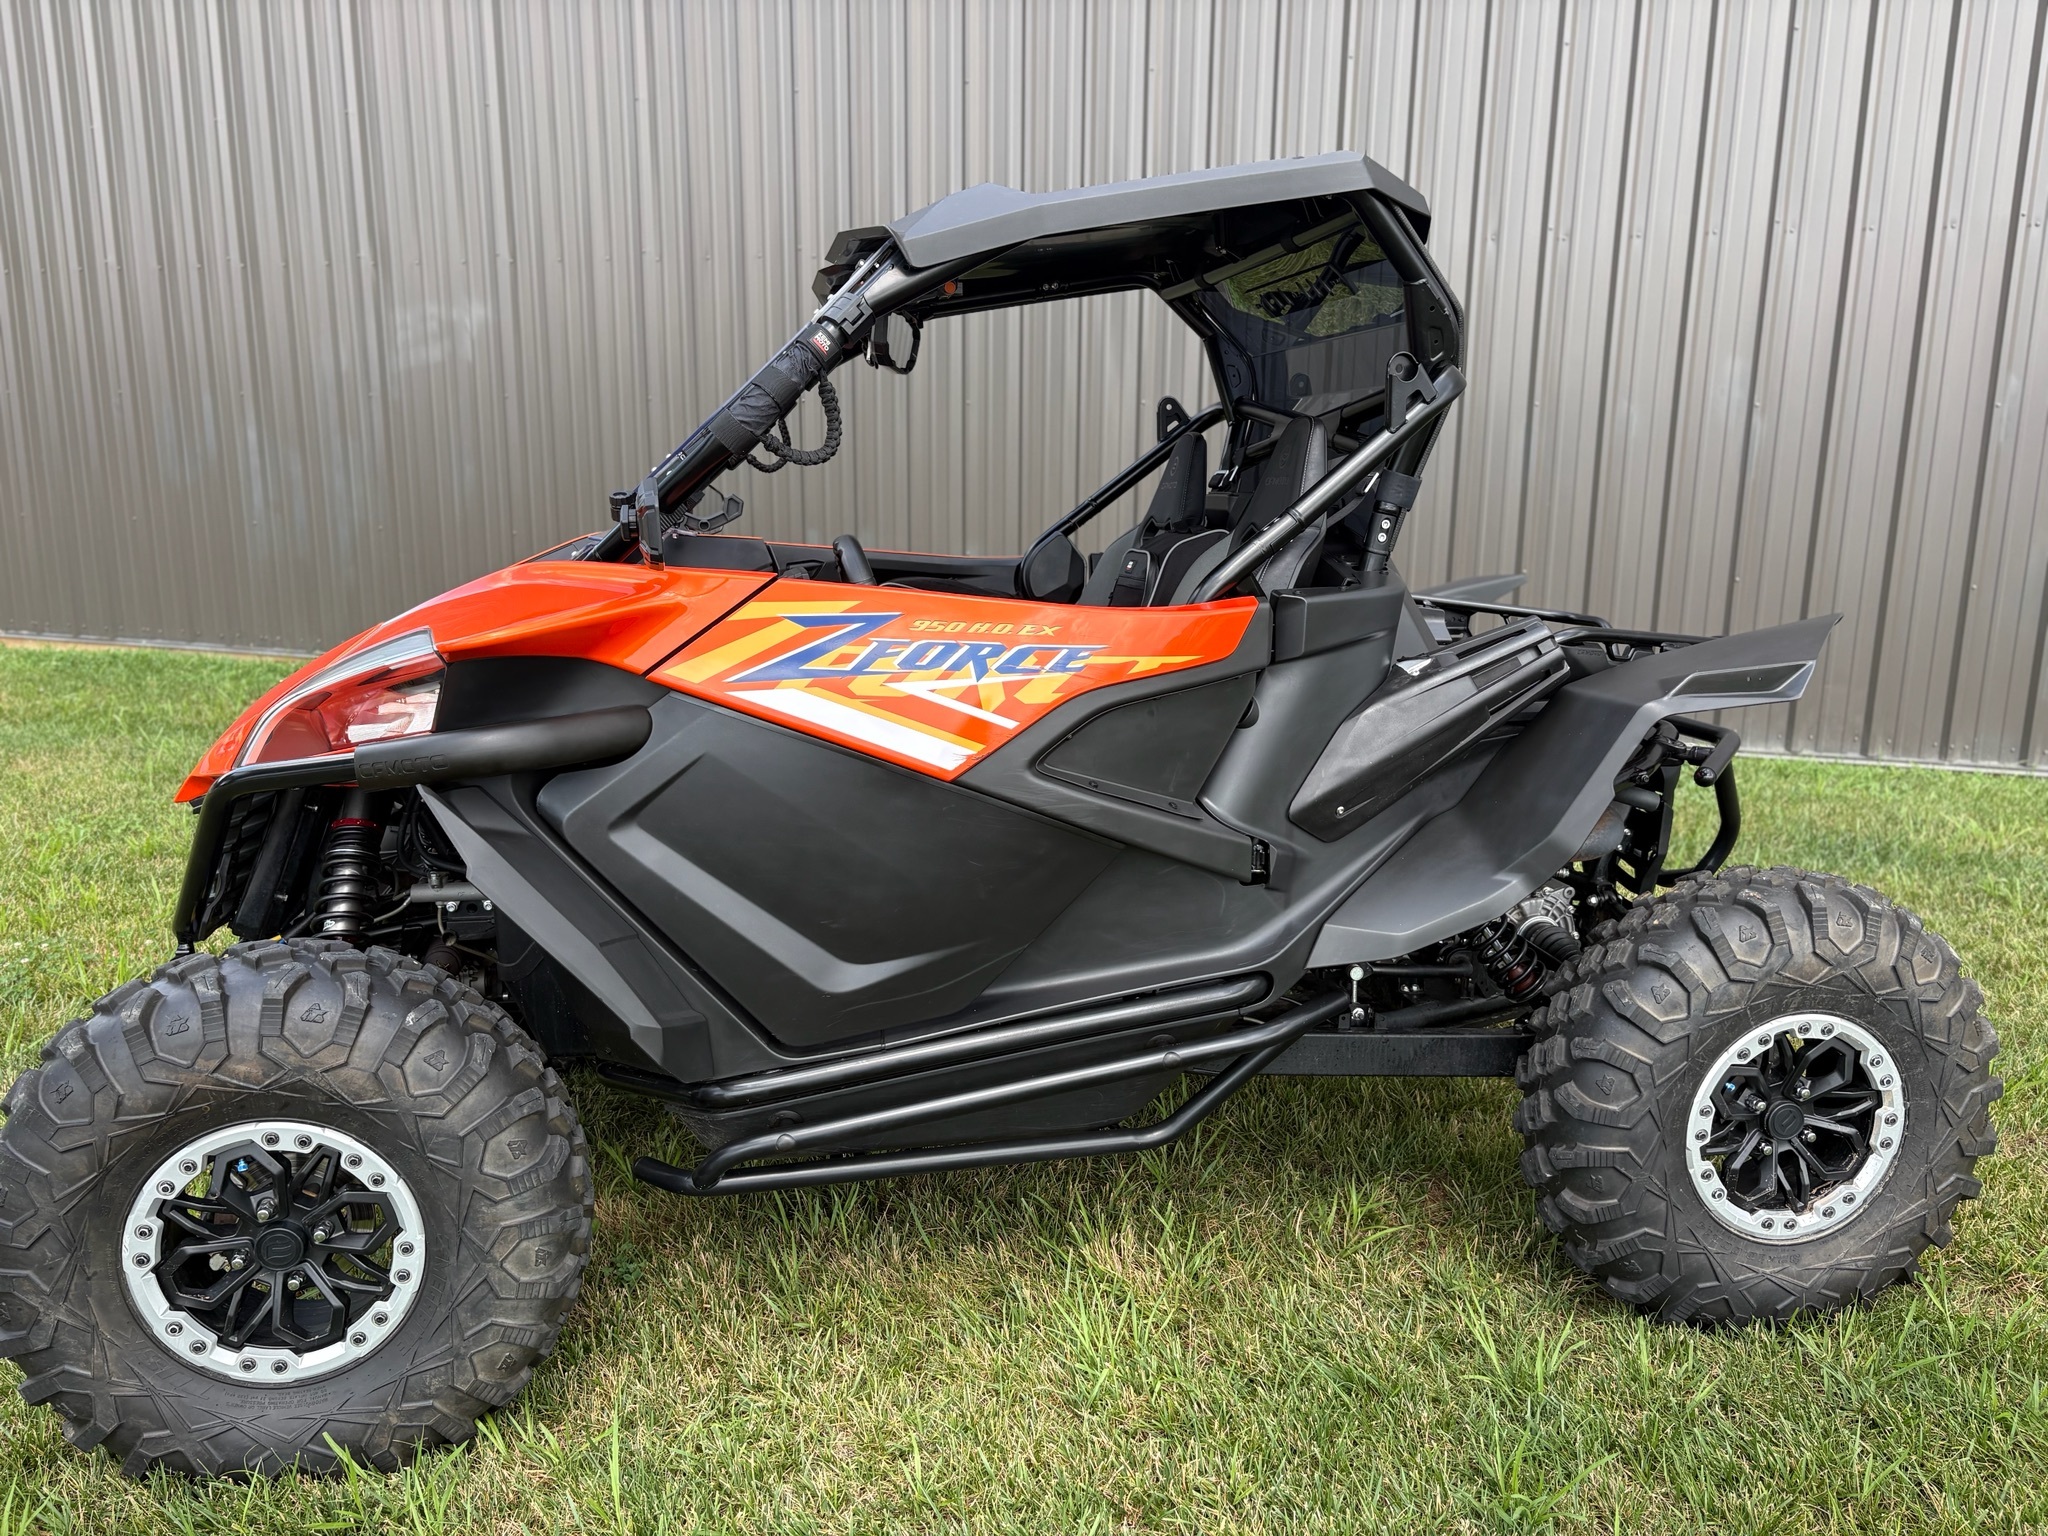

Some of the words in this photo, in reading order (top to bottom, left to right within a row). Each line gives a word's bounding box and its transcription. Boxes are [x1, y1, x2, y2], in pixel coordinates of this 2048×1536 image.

[813, 336, 829, 351] MOTO
[908, 619, 967, 633] 950
[966, 622, 1013, 635] H.O.
[1016, 624, 1064, 637] EX
[358, 754, 450, 779] CFMOTO
